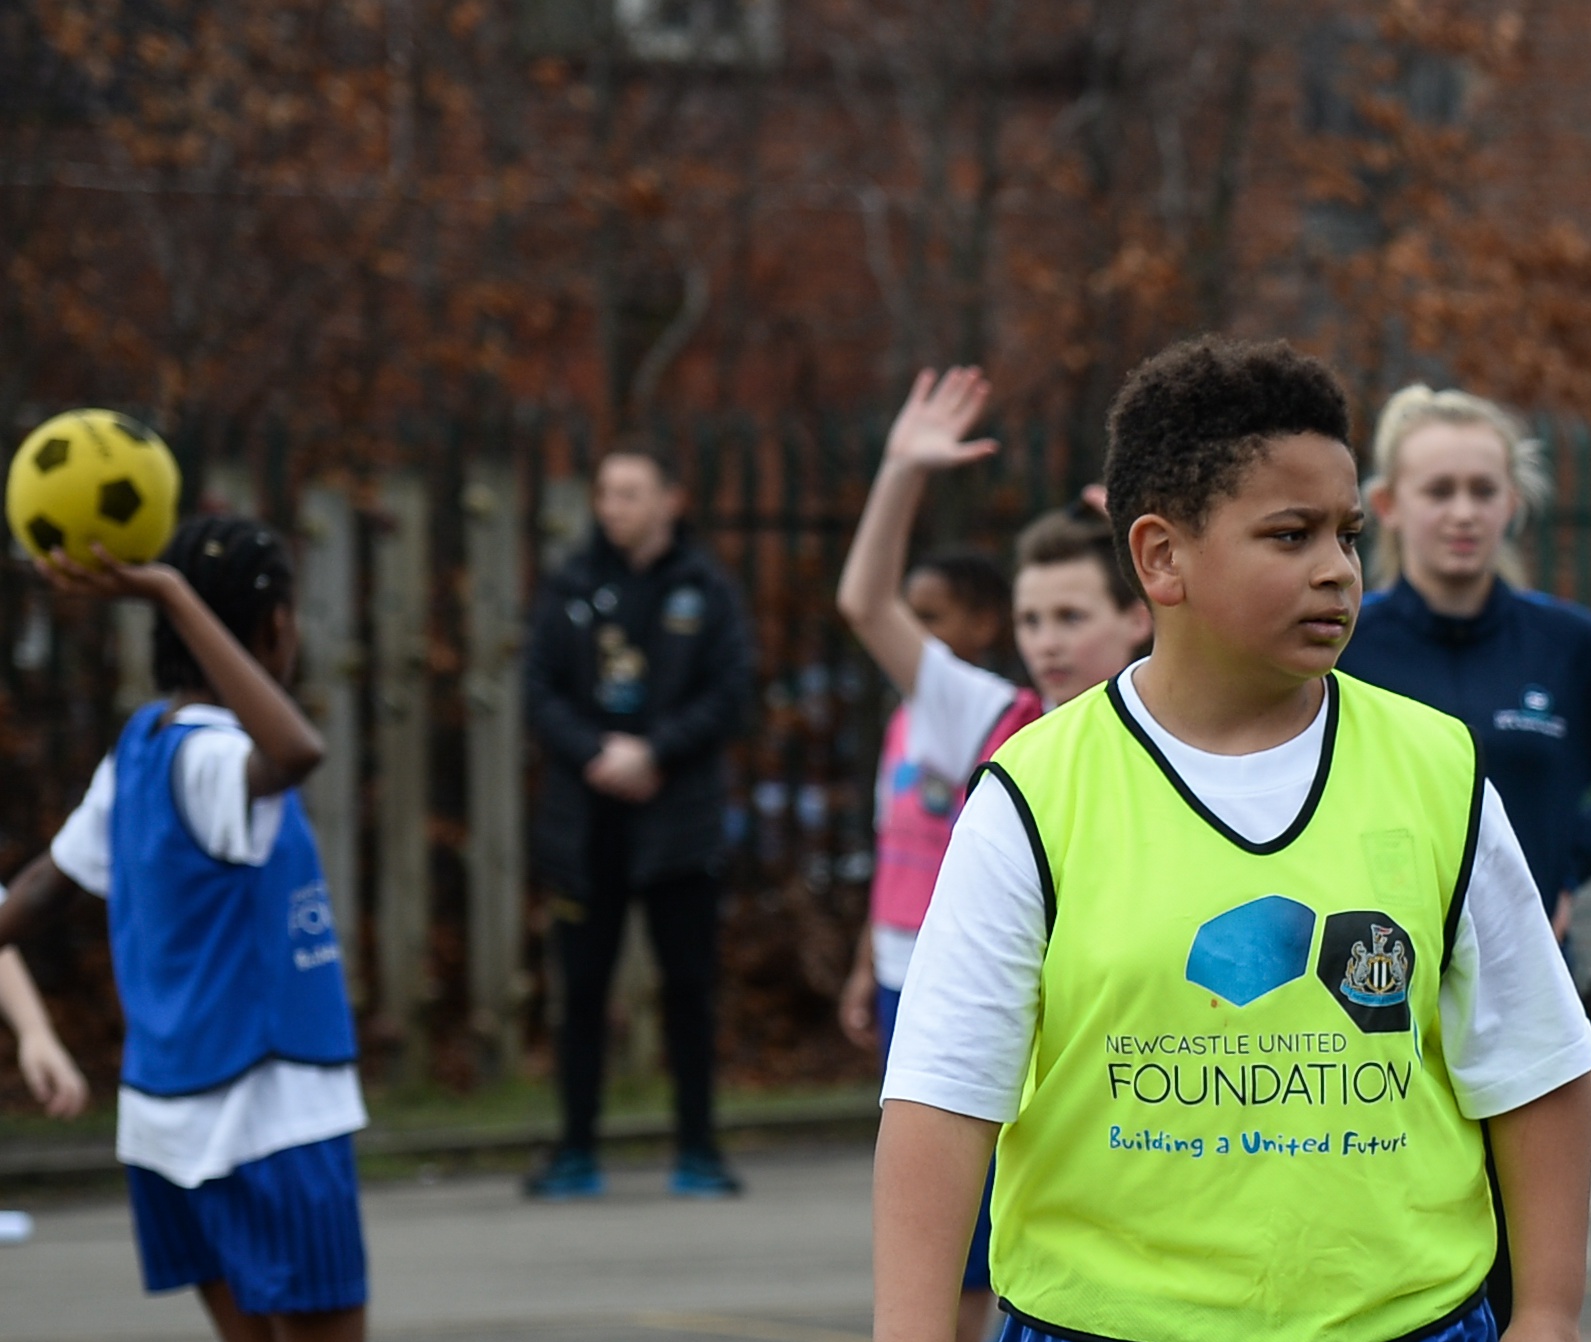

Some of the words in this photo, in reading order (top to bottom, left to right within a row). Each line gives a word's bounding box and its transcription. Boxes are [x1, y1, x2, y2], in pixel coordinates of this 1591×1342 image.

[1105, 1034, 1250, 1055] NEWCASTLE
[1258, 1033, 1347, 1053] UNITED
[1108, 1061, 1412, 1106] FOUNDATION
[1110, 1125, 1204, 1158] Building
[1216, 1136, 1230, 1154] a
[1241, 1131, 1330, 1157] United
